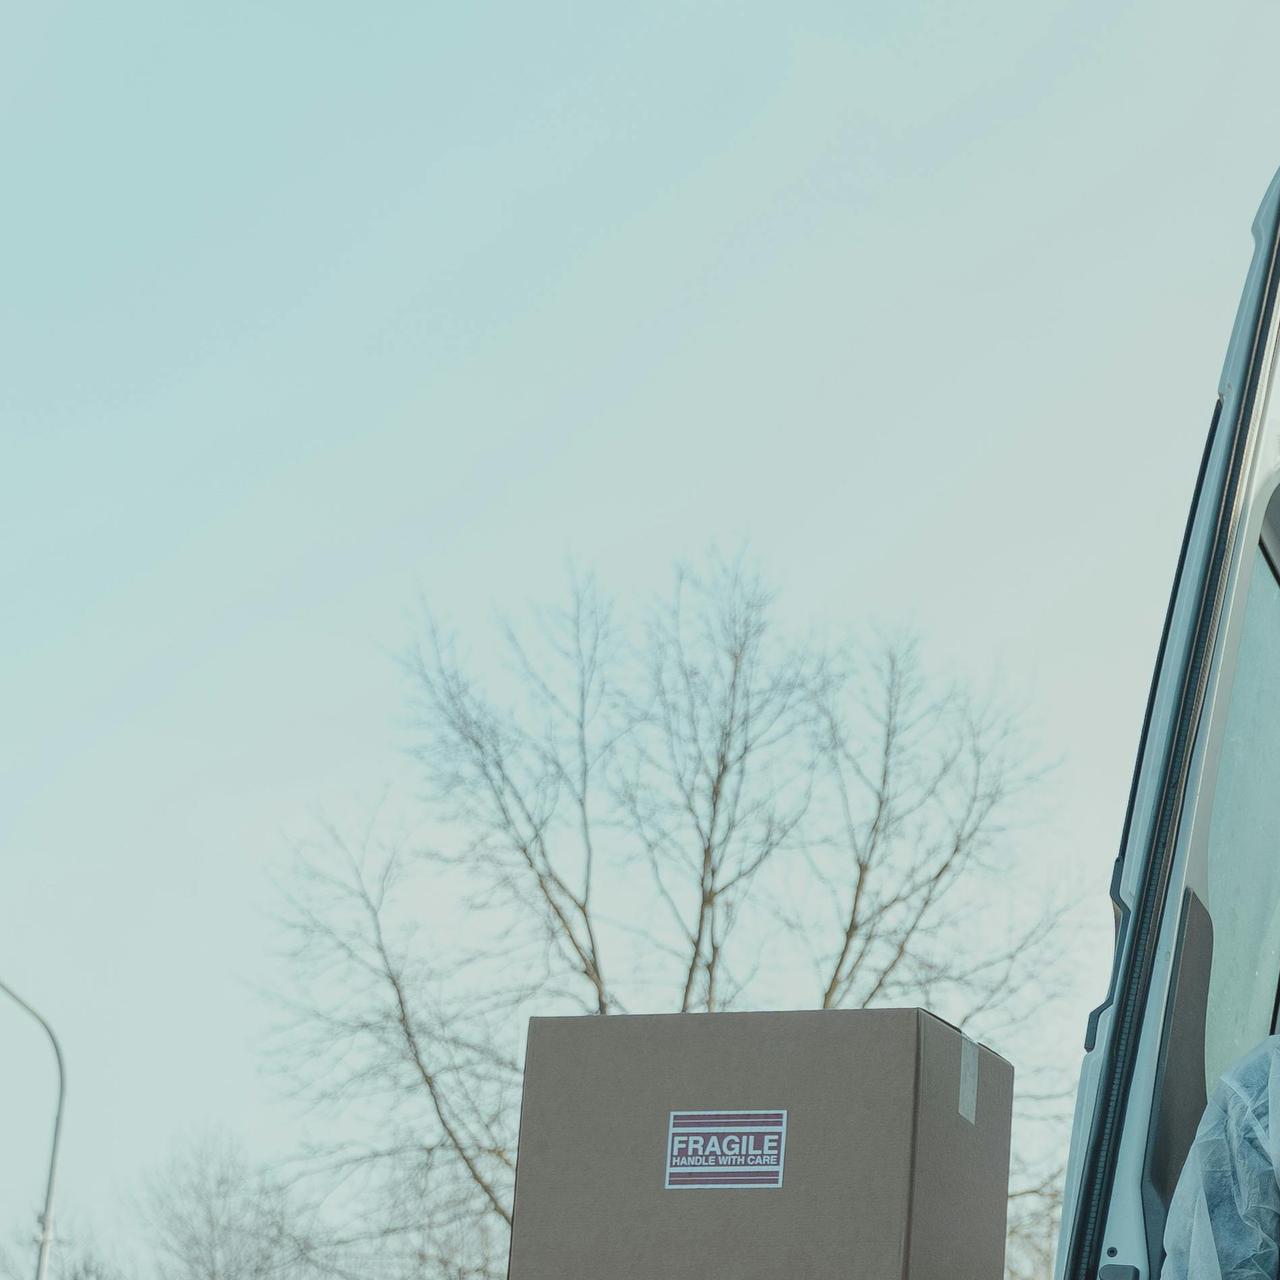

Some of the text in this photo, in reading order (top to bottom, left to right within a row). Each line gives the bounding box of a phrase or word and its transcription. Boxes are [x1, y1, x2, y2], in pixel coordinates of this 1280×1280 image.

[672, 1135, 779, 1155] FRAGILE
[672, 1155, 777, 1166] HANDLE WITH CARE
